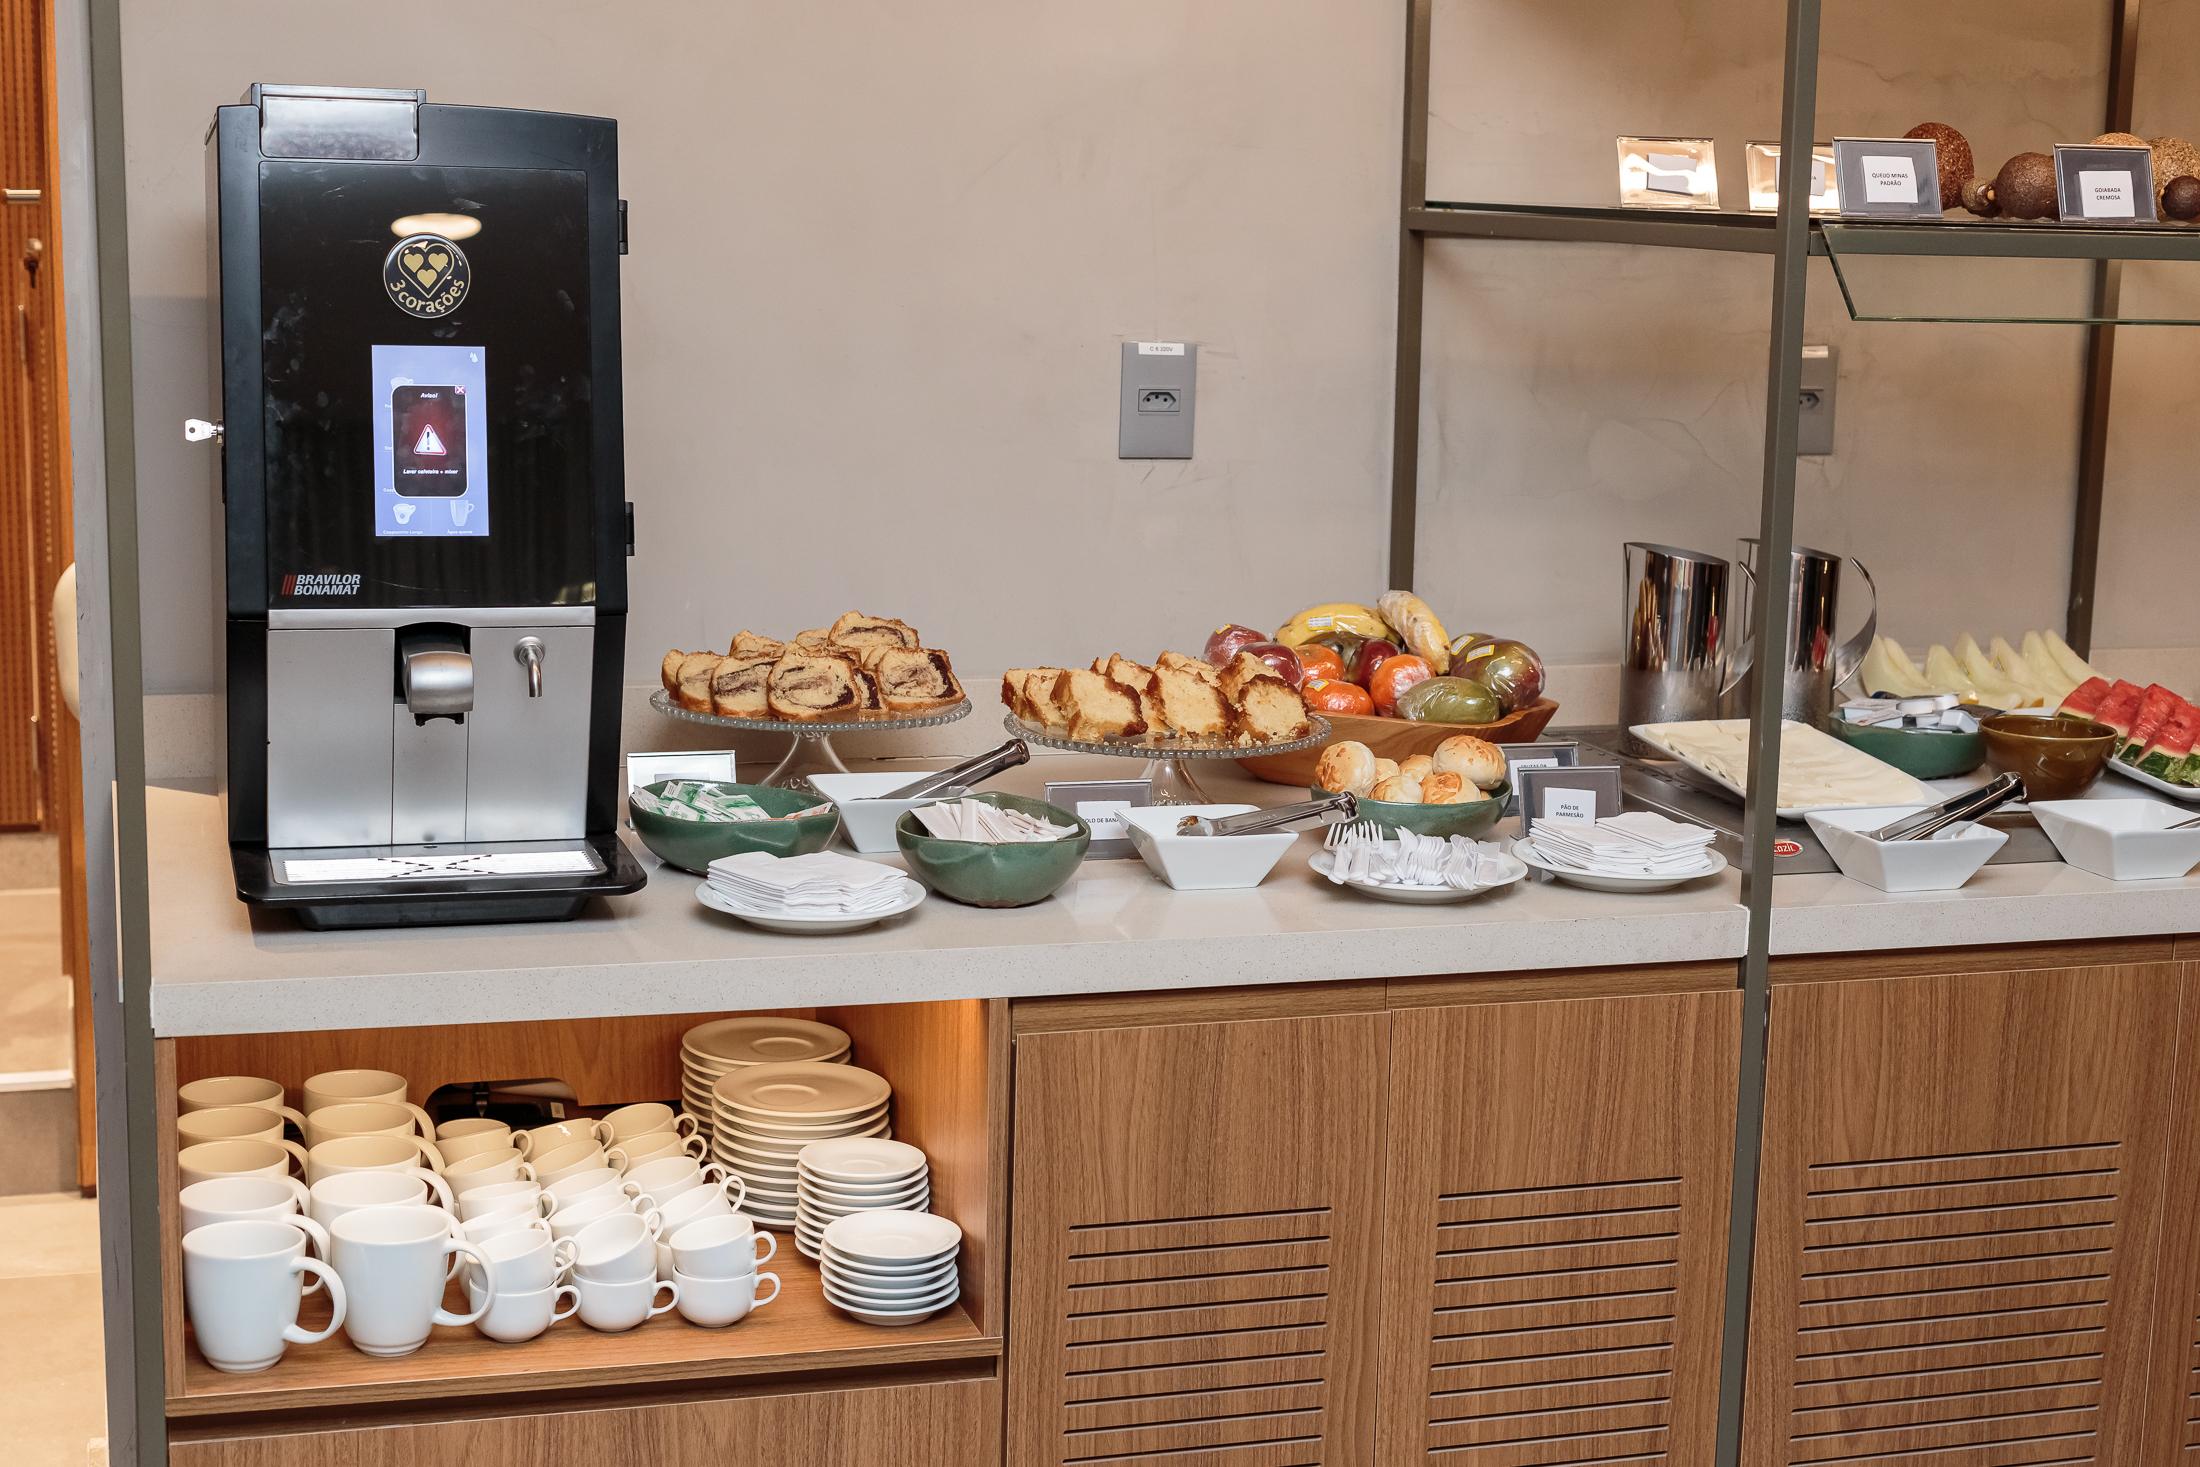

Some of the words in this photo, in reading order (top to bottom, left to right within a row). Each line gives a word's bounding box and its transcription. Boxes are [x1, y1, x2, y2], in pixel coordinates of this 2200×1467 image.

[390, 279, 406, 292] 3
[398, 279, 465, 313] corações
[296, 574, 361, 585] BRAVILOR
[294, 584, 360, 595] BONAMAT
